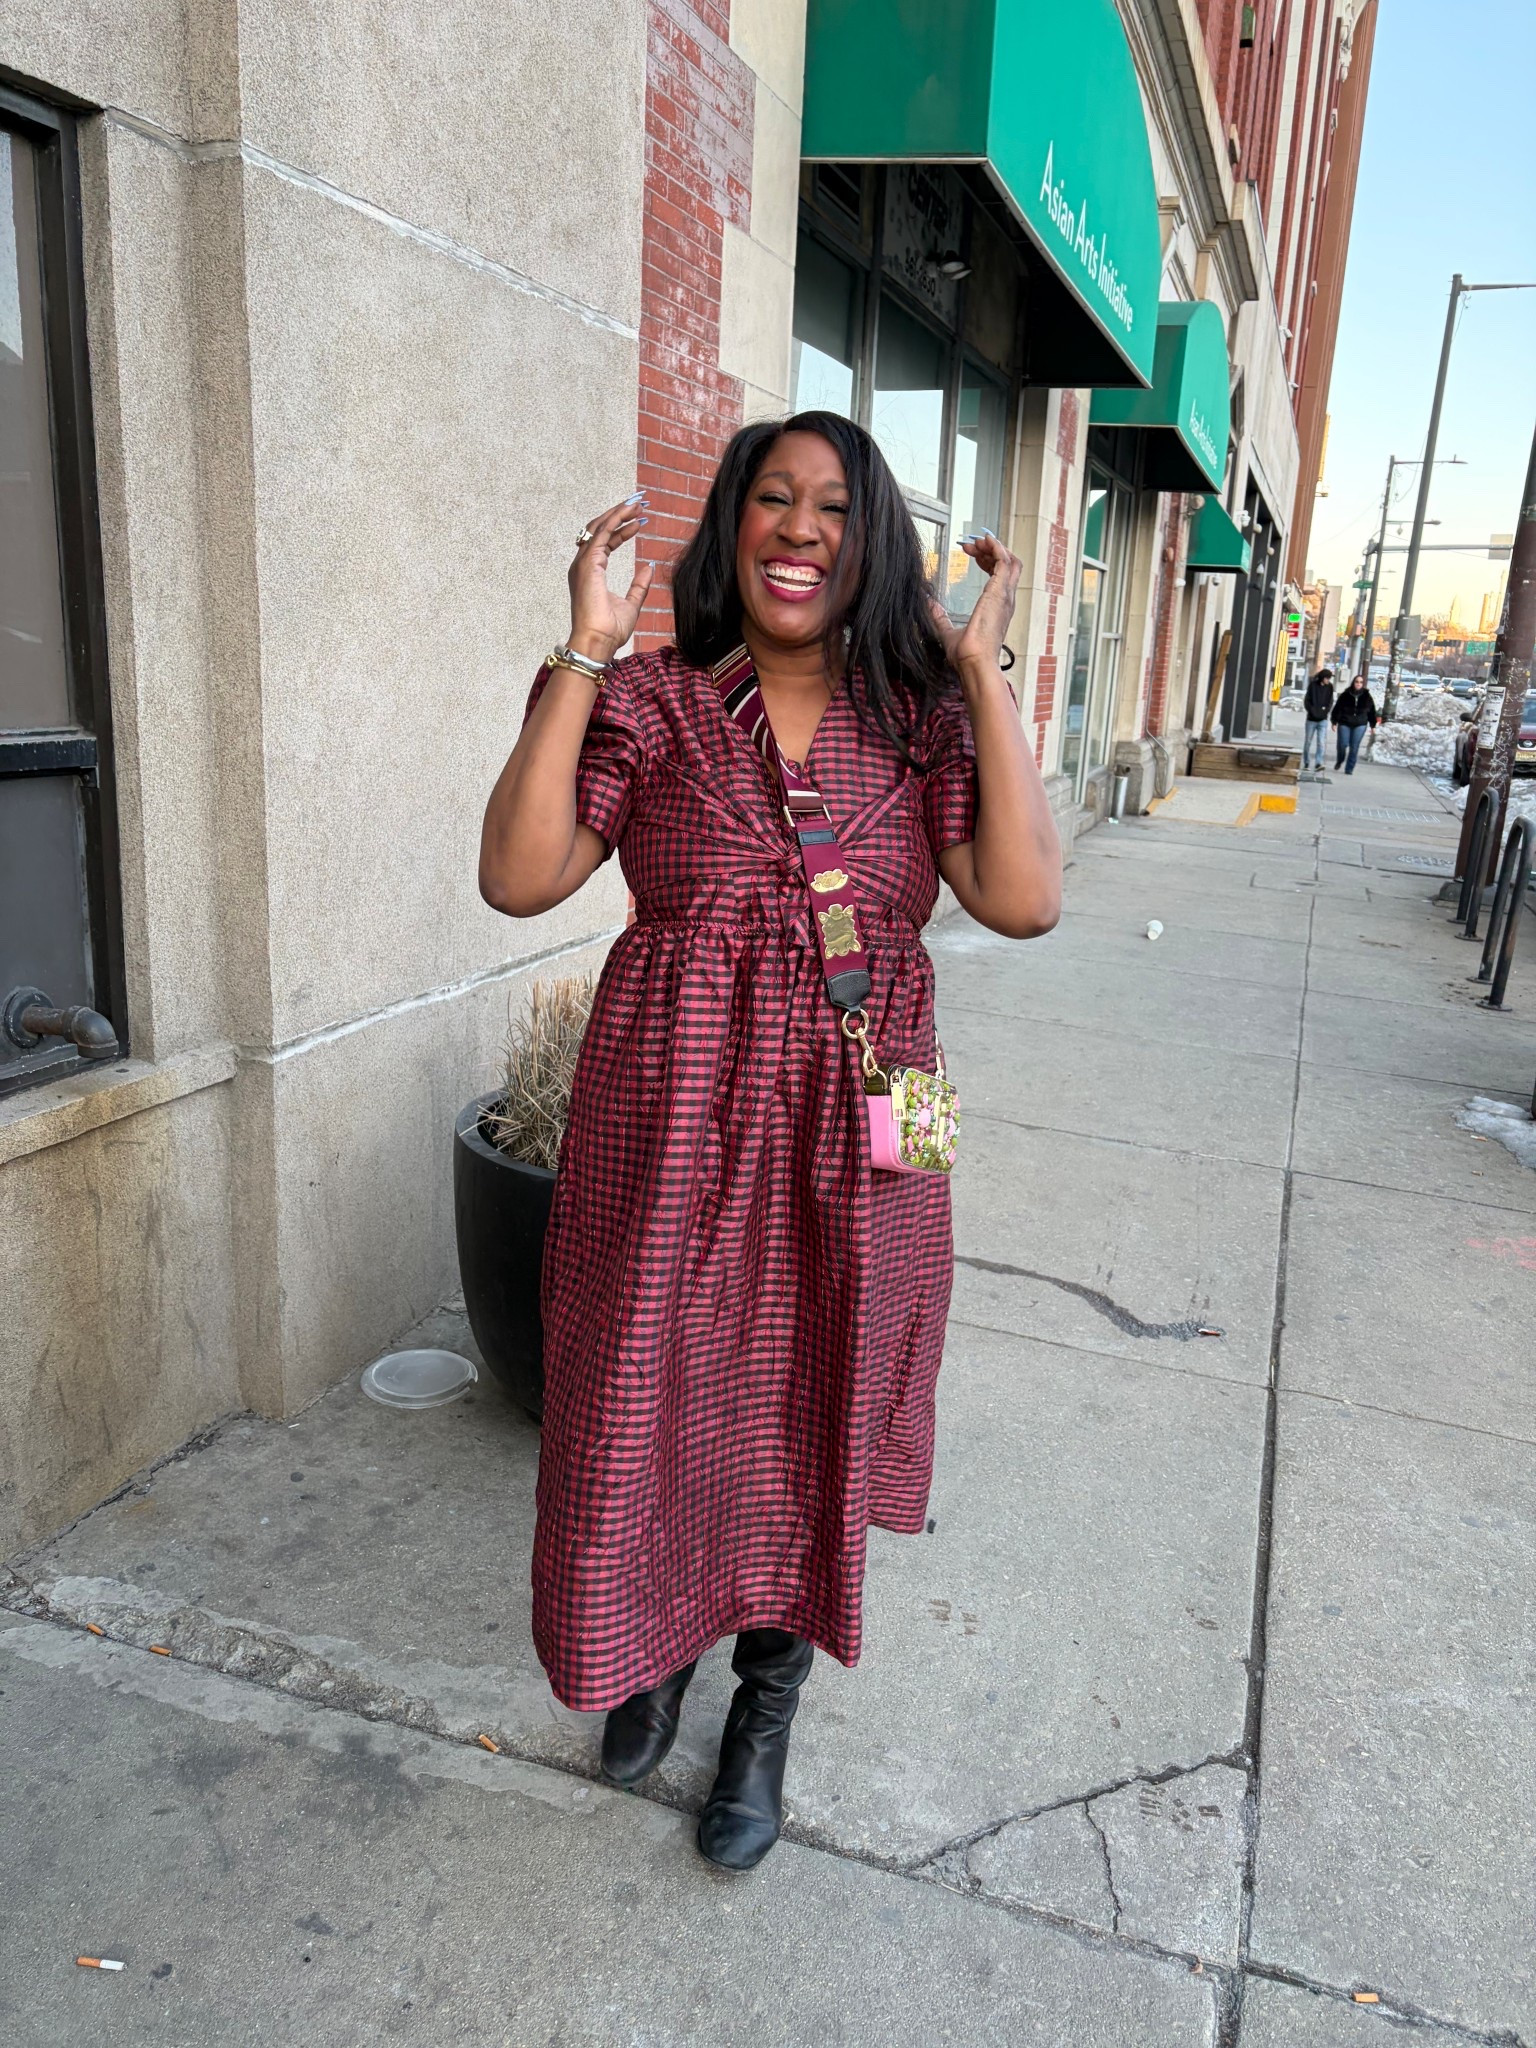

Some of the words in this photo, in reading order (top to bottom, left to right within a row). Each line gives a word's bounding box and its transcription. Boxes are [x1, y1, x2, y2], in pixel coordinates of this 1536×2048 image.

[1040, 140, 1075, 246] Asian
[1074, 198, 1099, 280] Arts
[1097, 232, 1133, 333] Initiative
